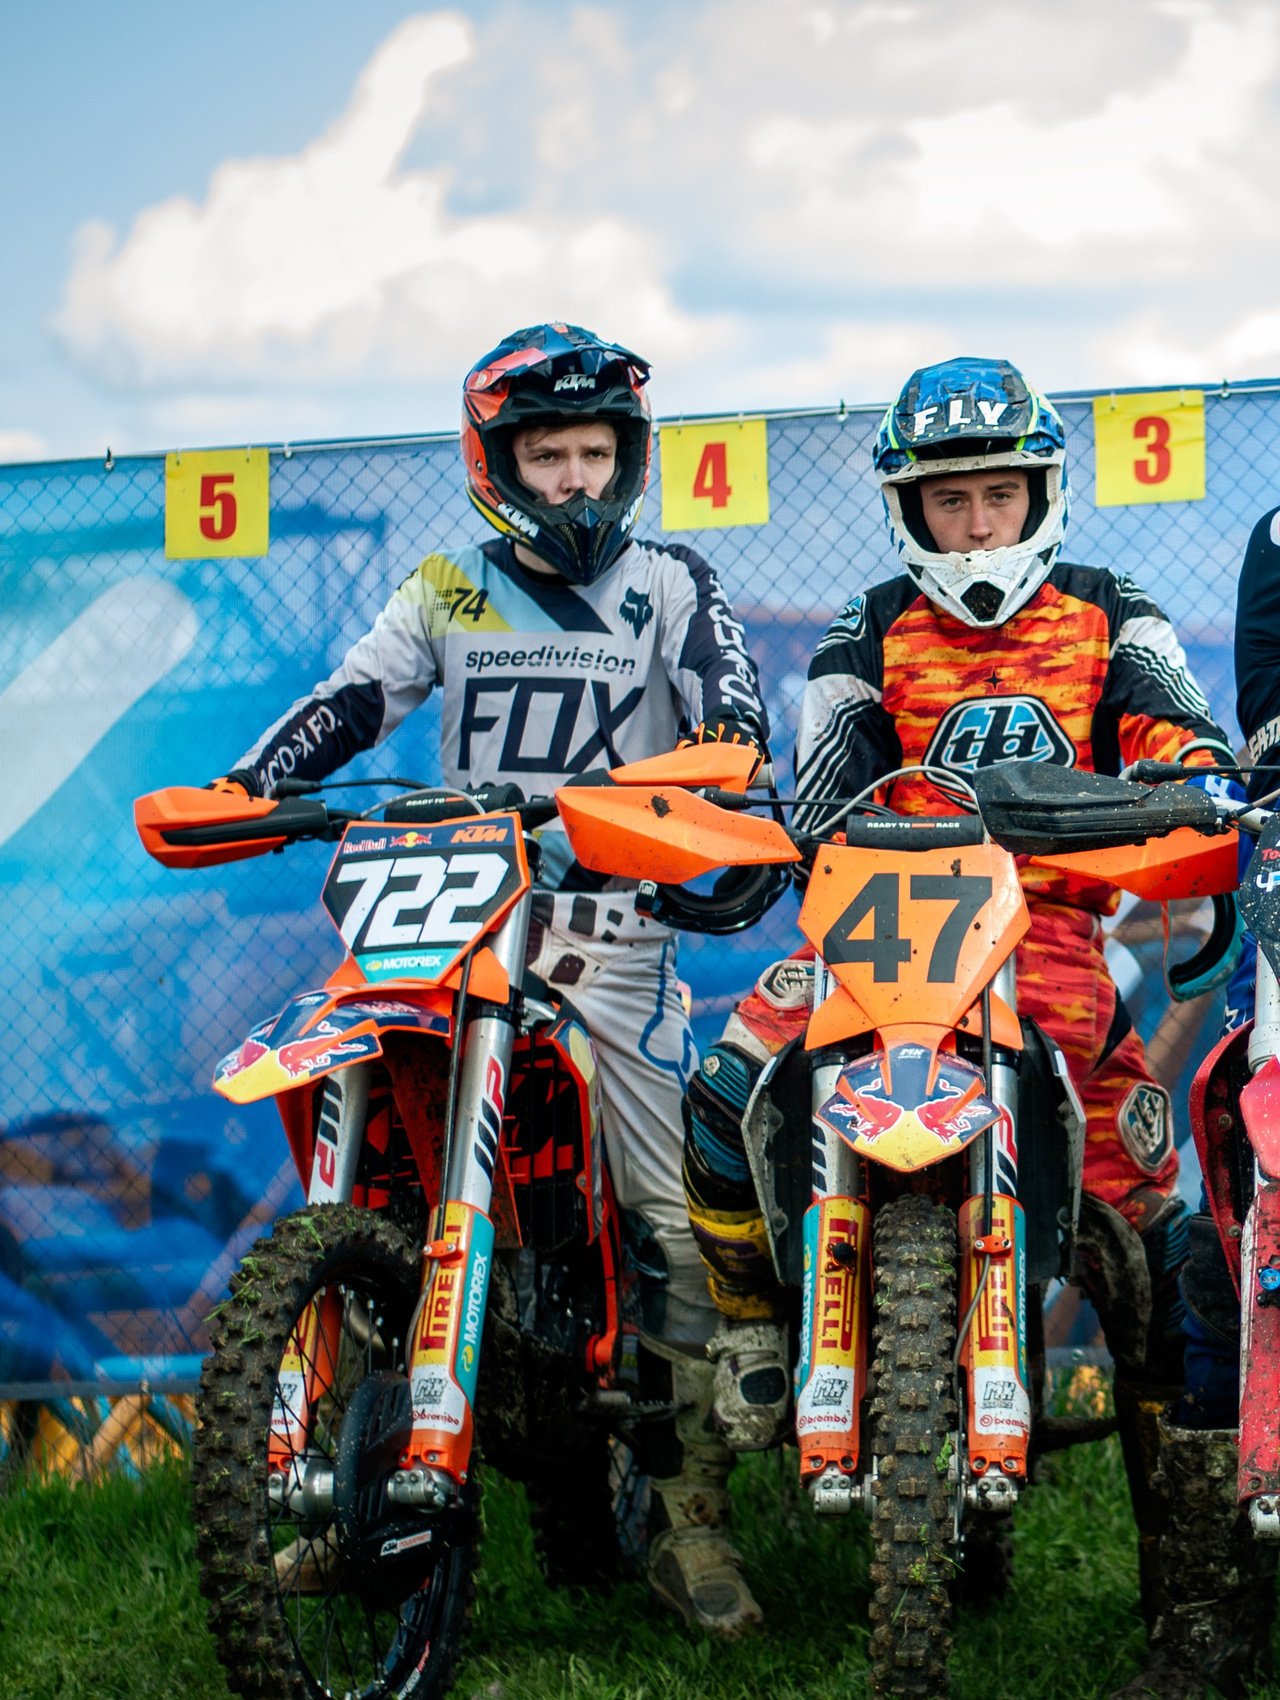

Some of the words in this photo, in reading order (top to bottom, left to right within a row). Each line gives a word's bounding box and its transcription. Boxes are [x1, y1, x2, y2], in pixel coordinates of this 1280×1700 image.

[553, 373, 596, 392] KTM
[913, 400, 1009, 436] FLY
[1133, 415, 1171, 485] 3
[692, 442, 732, 508] 4
[199, 474, 238, 541] 5
[497, 503, 540, 539] KTM
[449, 587, 489, 623] 74
[465, 645, 637, 676] speedivision
[457, 677, 647, 774] FOX
[405, 799, 435, 807] READY
[433, 798, 446, 806] TO
[449, 825, 509, 844] KTM
[866, 821, 897, 829] READY
[342, 841, 364, 855] Red
[364, 838, 387, 852] Bull
[336, 853, 510, 951] 722
[822, 872, 993, 984] 47
[382, 954, 443, 970] MOTOREX
[418, 1224, 463, 1351] PIREI
[460, 1250, 488, 1345] MOTOREX
[821, 1217, 860, 1351] PIELLI
[973, 1217, 1010, 1352] PIREI
[800, 1271, 816, 1367] MOTOREX
[812, 1378, 848, 1398] MX
[983, 1380, 1017, 1401] MX
[420, 1410, 460, 1426] brembo
[807, 1414, 848, 1425] brembo
